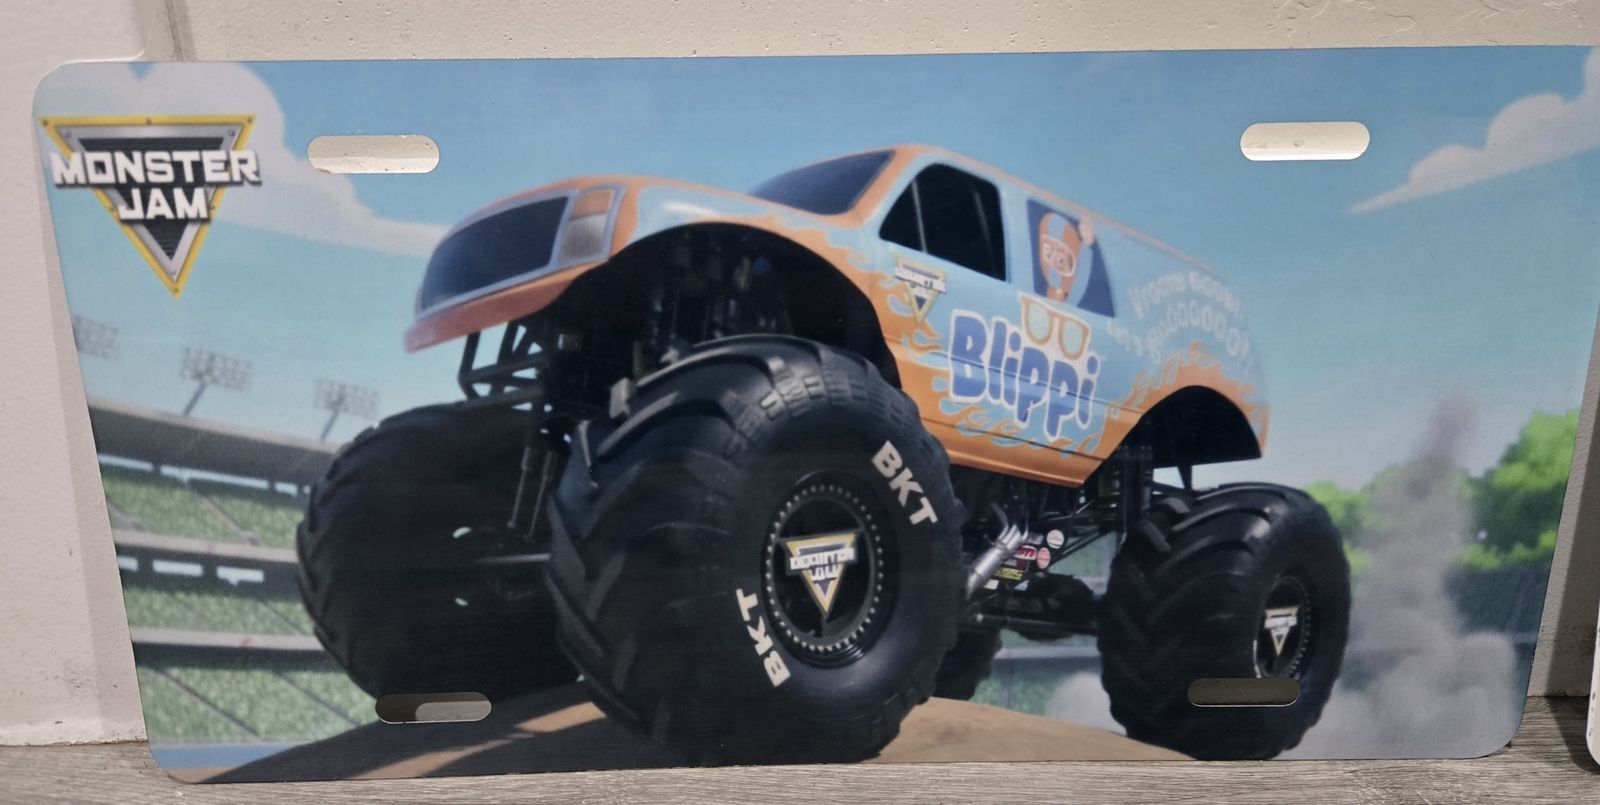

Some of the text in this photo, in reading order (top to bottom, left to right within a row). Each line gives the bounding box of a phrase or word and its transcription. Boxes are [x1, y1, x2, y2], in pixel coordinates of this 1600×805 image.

[51, 150, 262, 188] MONSTER
[117, 186, 210, 222] JAM
[950, 309, 1101, 441] Blippi
[871, 440, 938, 525] BKT
[736, 588, 791, 687] BKT
